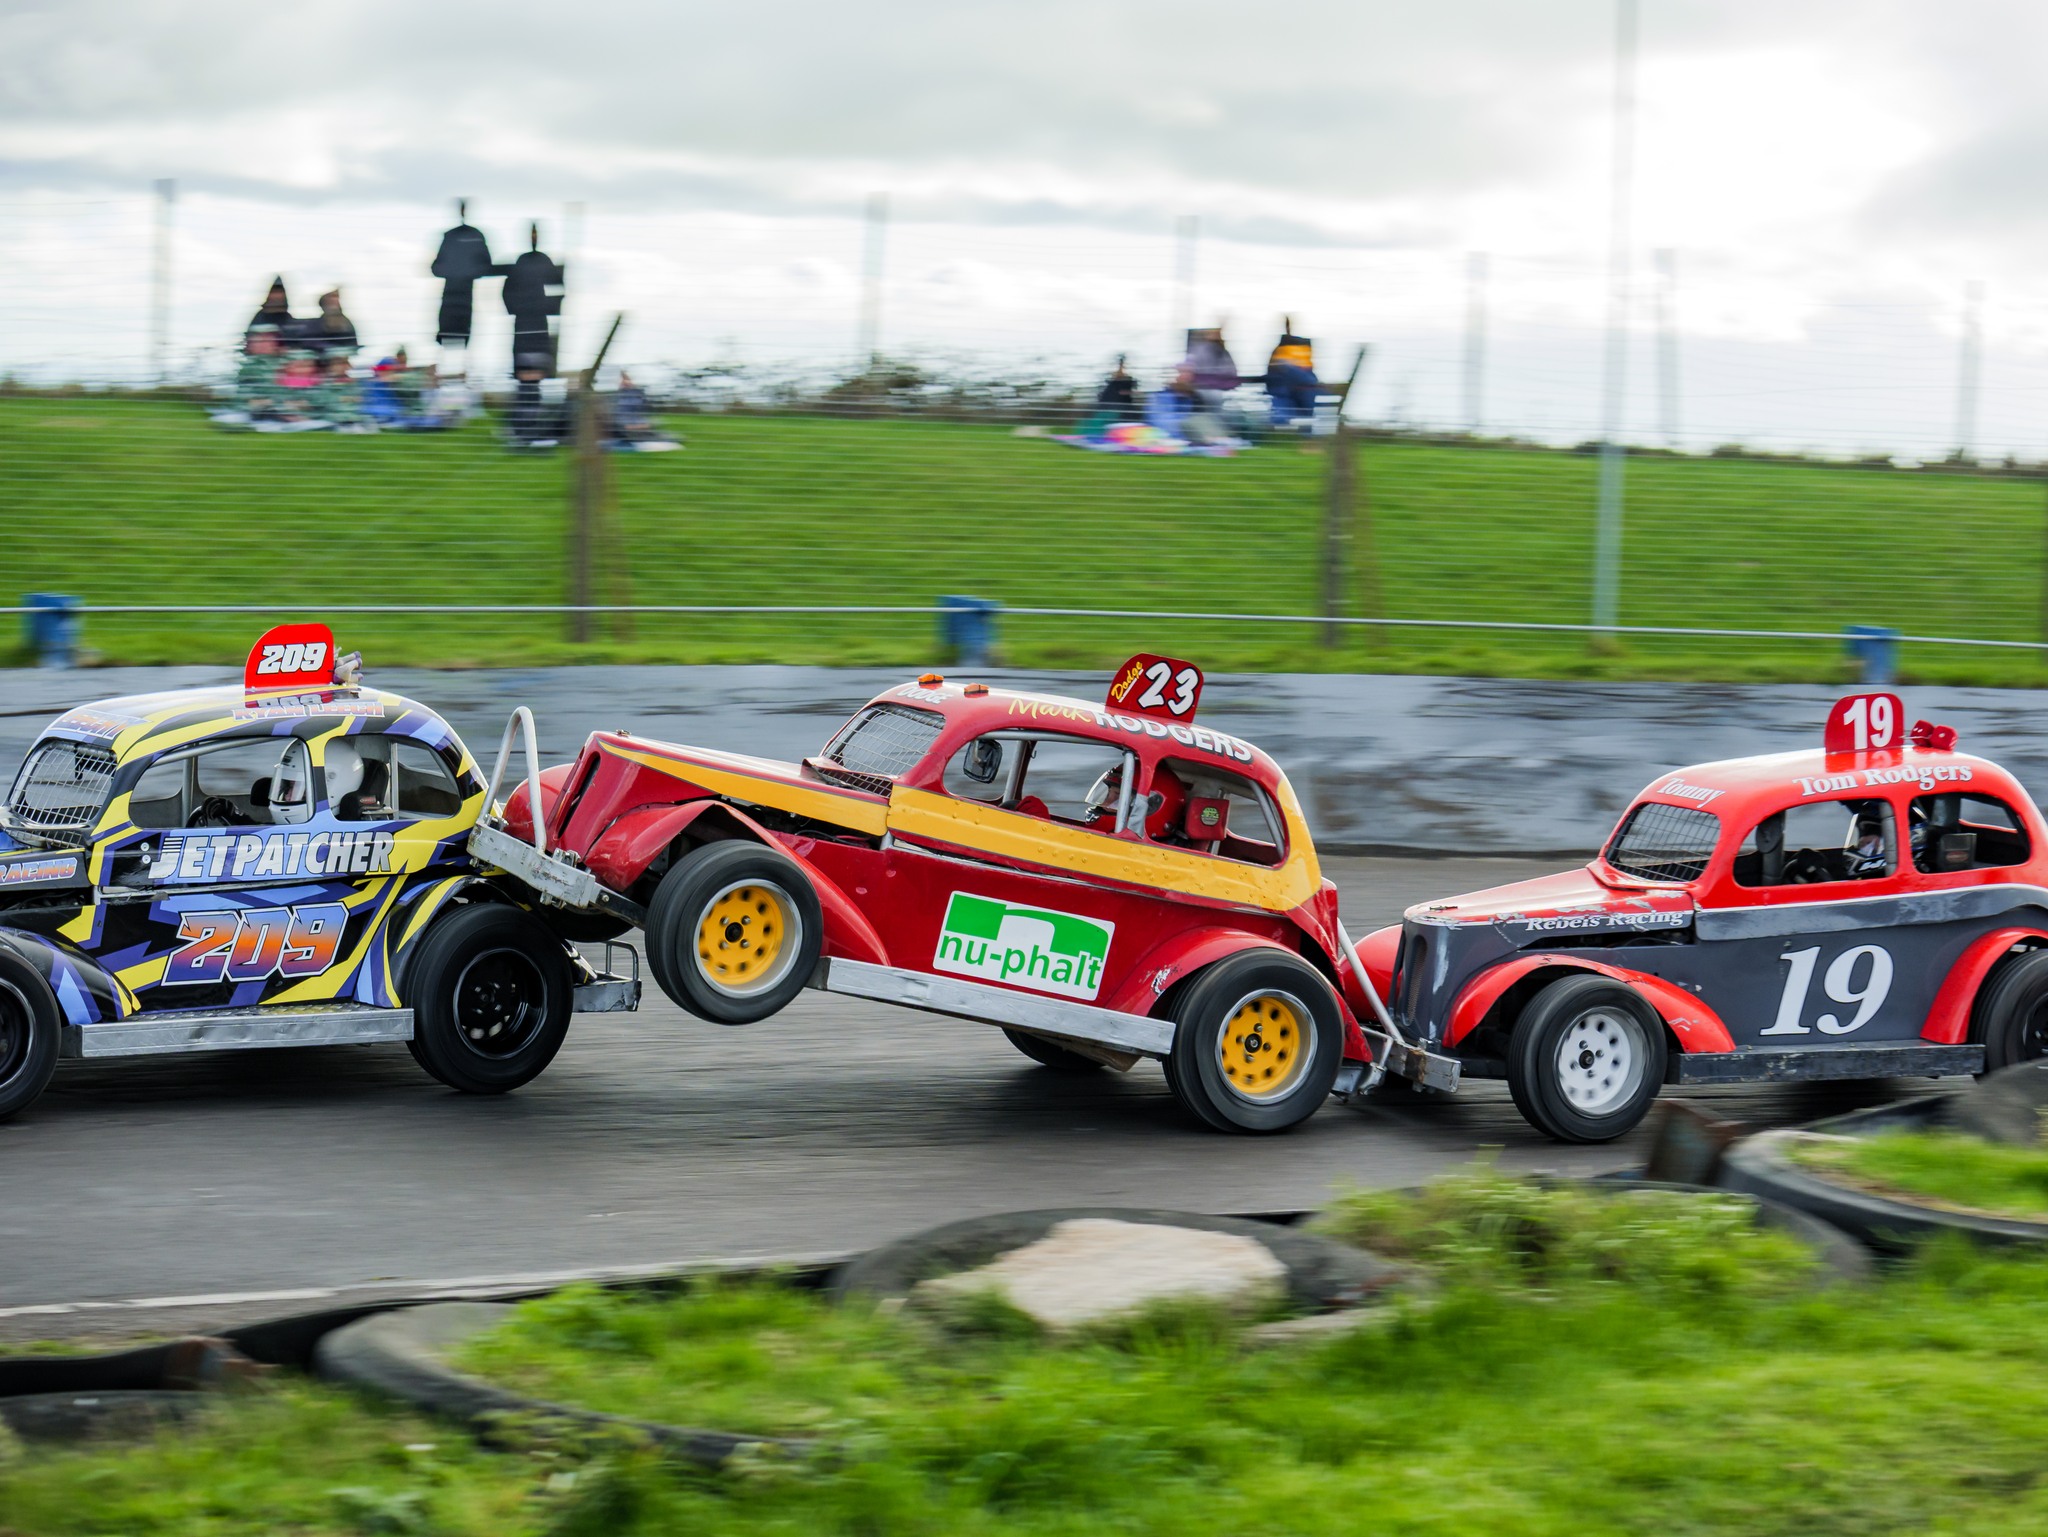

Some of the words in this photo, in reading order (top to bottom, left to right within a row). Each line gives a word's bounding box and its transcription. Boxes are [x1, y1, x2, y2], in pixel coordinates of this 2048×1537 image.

[256, 642, 328, 674] 209
[1111, 660, 1144, 701] Dodge
[1137, 660, 1199, 716] 23
[1008, 699, 1091, 723] Mark
[1091, 710, 1254, 764] RODGERS
[1843, 696, 1894, 750] 19
[1656, 777, 1726, 808] Tommy
[1792, 775, 1858, 796] Tom
[1861, 765, 1973, 791] Rodgers
[148, 831, 394, 880] JETPATCHER
[1606, 910, 1684, 926] Racing
[160, 901, 350, 987] 209
[939, 935, 1101, 990] nu-phalt
[1759, 944, 1894, 1036] 19
